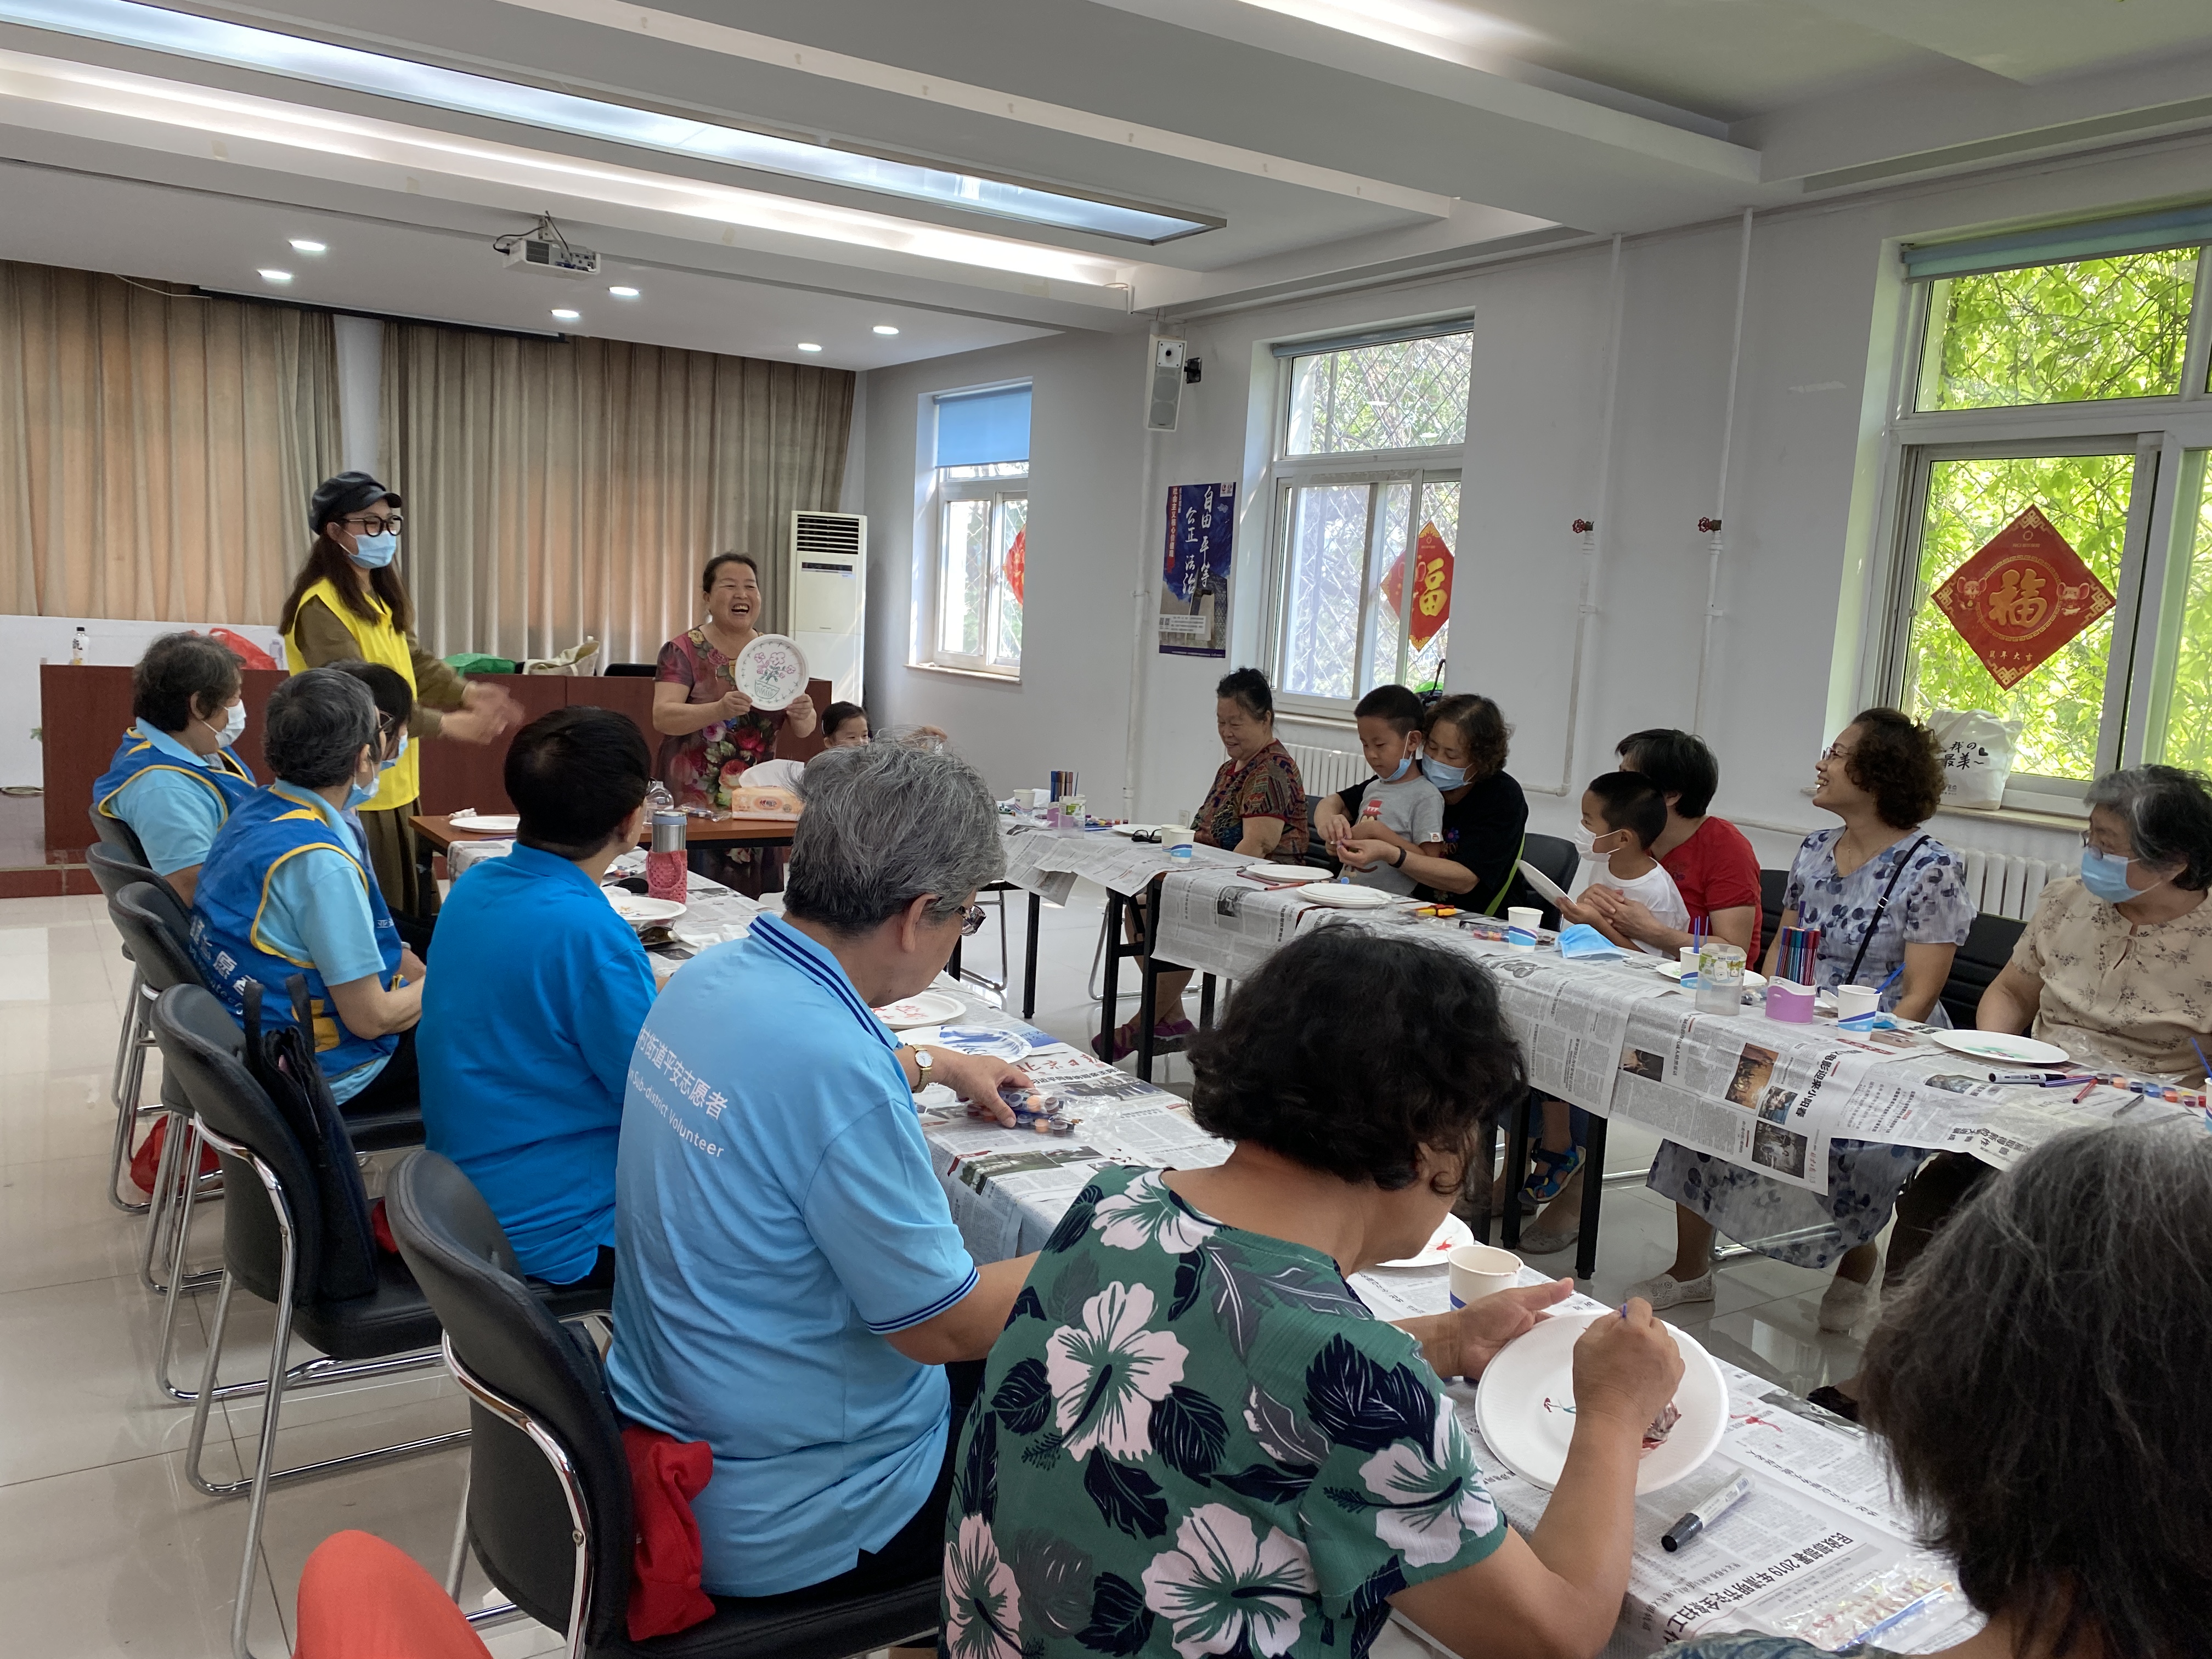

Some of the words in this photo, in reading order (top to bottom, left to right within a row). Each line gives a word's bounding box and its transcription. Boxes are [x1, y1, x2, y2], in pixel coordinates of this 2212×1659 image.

[1988, 568, 2048, 627] 福
[1989, 650, 2033, 661] 鼠年大吉
[633, 1070, 669, 1118] Sub-district
[669, 1108, 725, 1158] Volunteer
